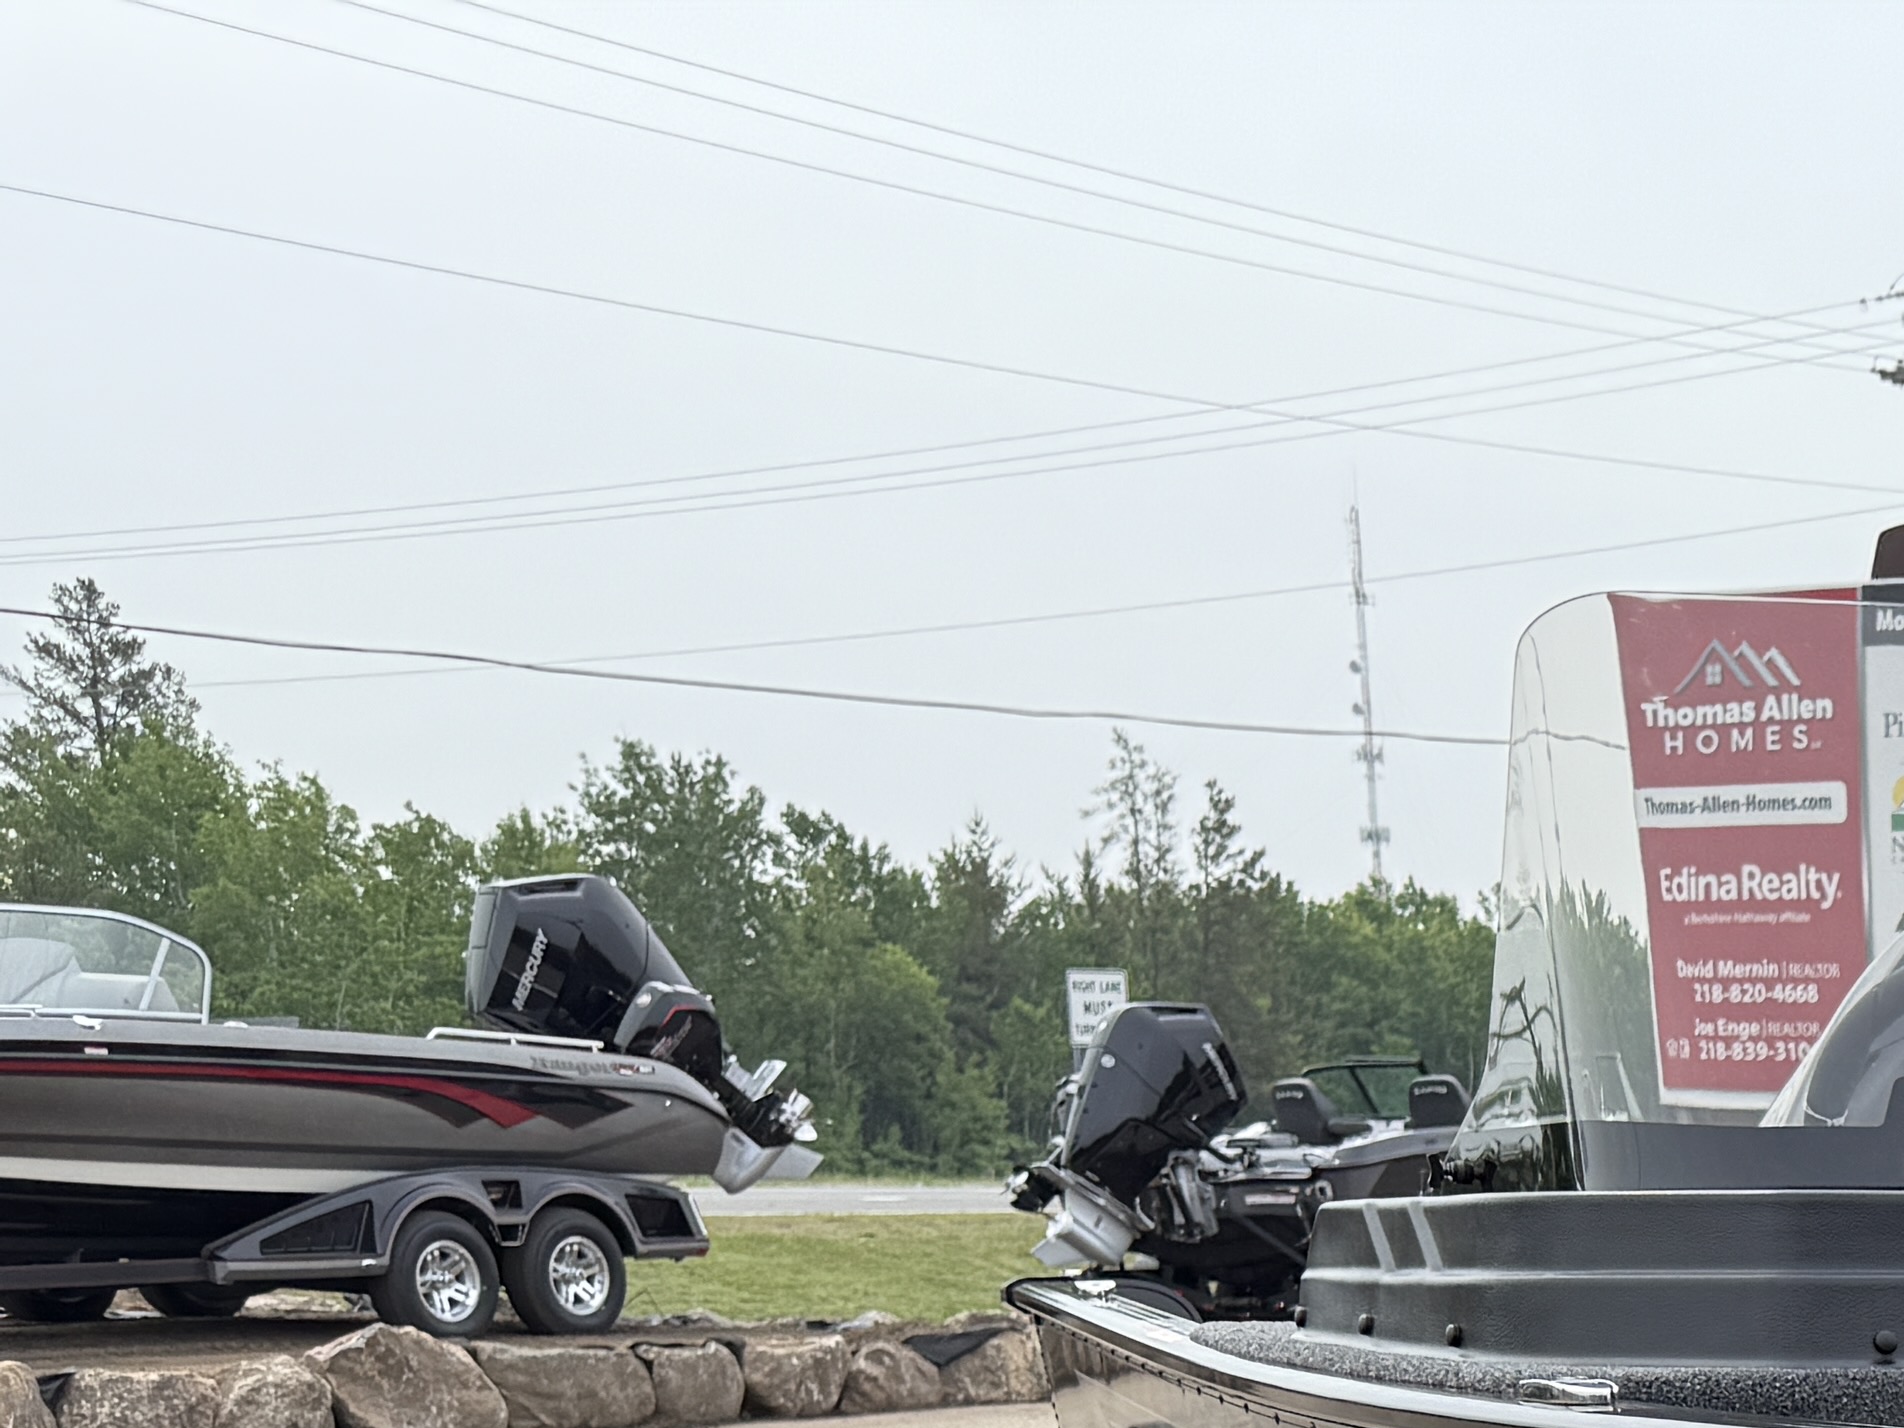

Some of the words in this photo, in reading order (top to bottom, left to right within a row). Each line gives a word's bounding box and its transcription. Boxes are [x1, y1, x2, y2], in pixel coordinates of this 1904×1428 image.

[1640, 696, 1756, 727] Thomas
[1760, 692, 1833, 722] Allen
[1664, 724, 1809, 755] HOMES
[1644, 794, 1833, 817] Thomas-Allen-Homes.com
[1659, 866, 1738, 902] Edina
[512, 928, 548, 1012] MERCURY
[1693, 982, 1819, 1004] 218-820-4668
[1716, 1017, 1761, 1041] Enge
[1698, 1041, 1812, 1062] 218-839-310
